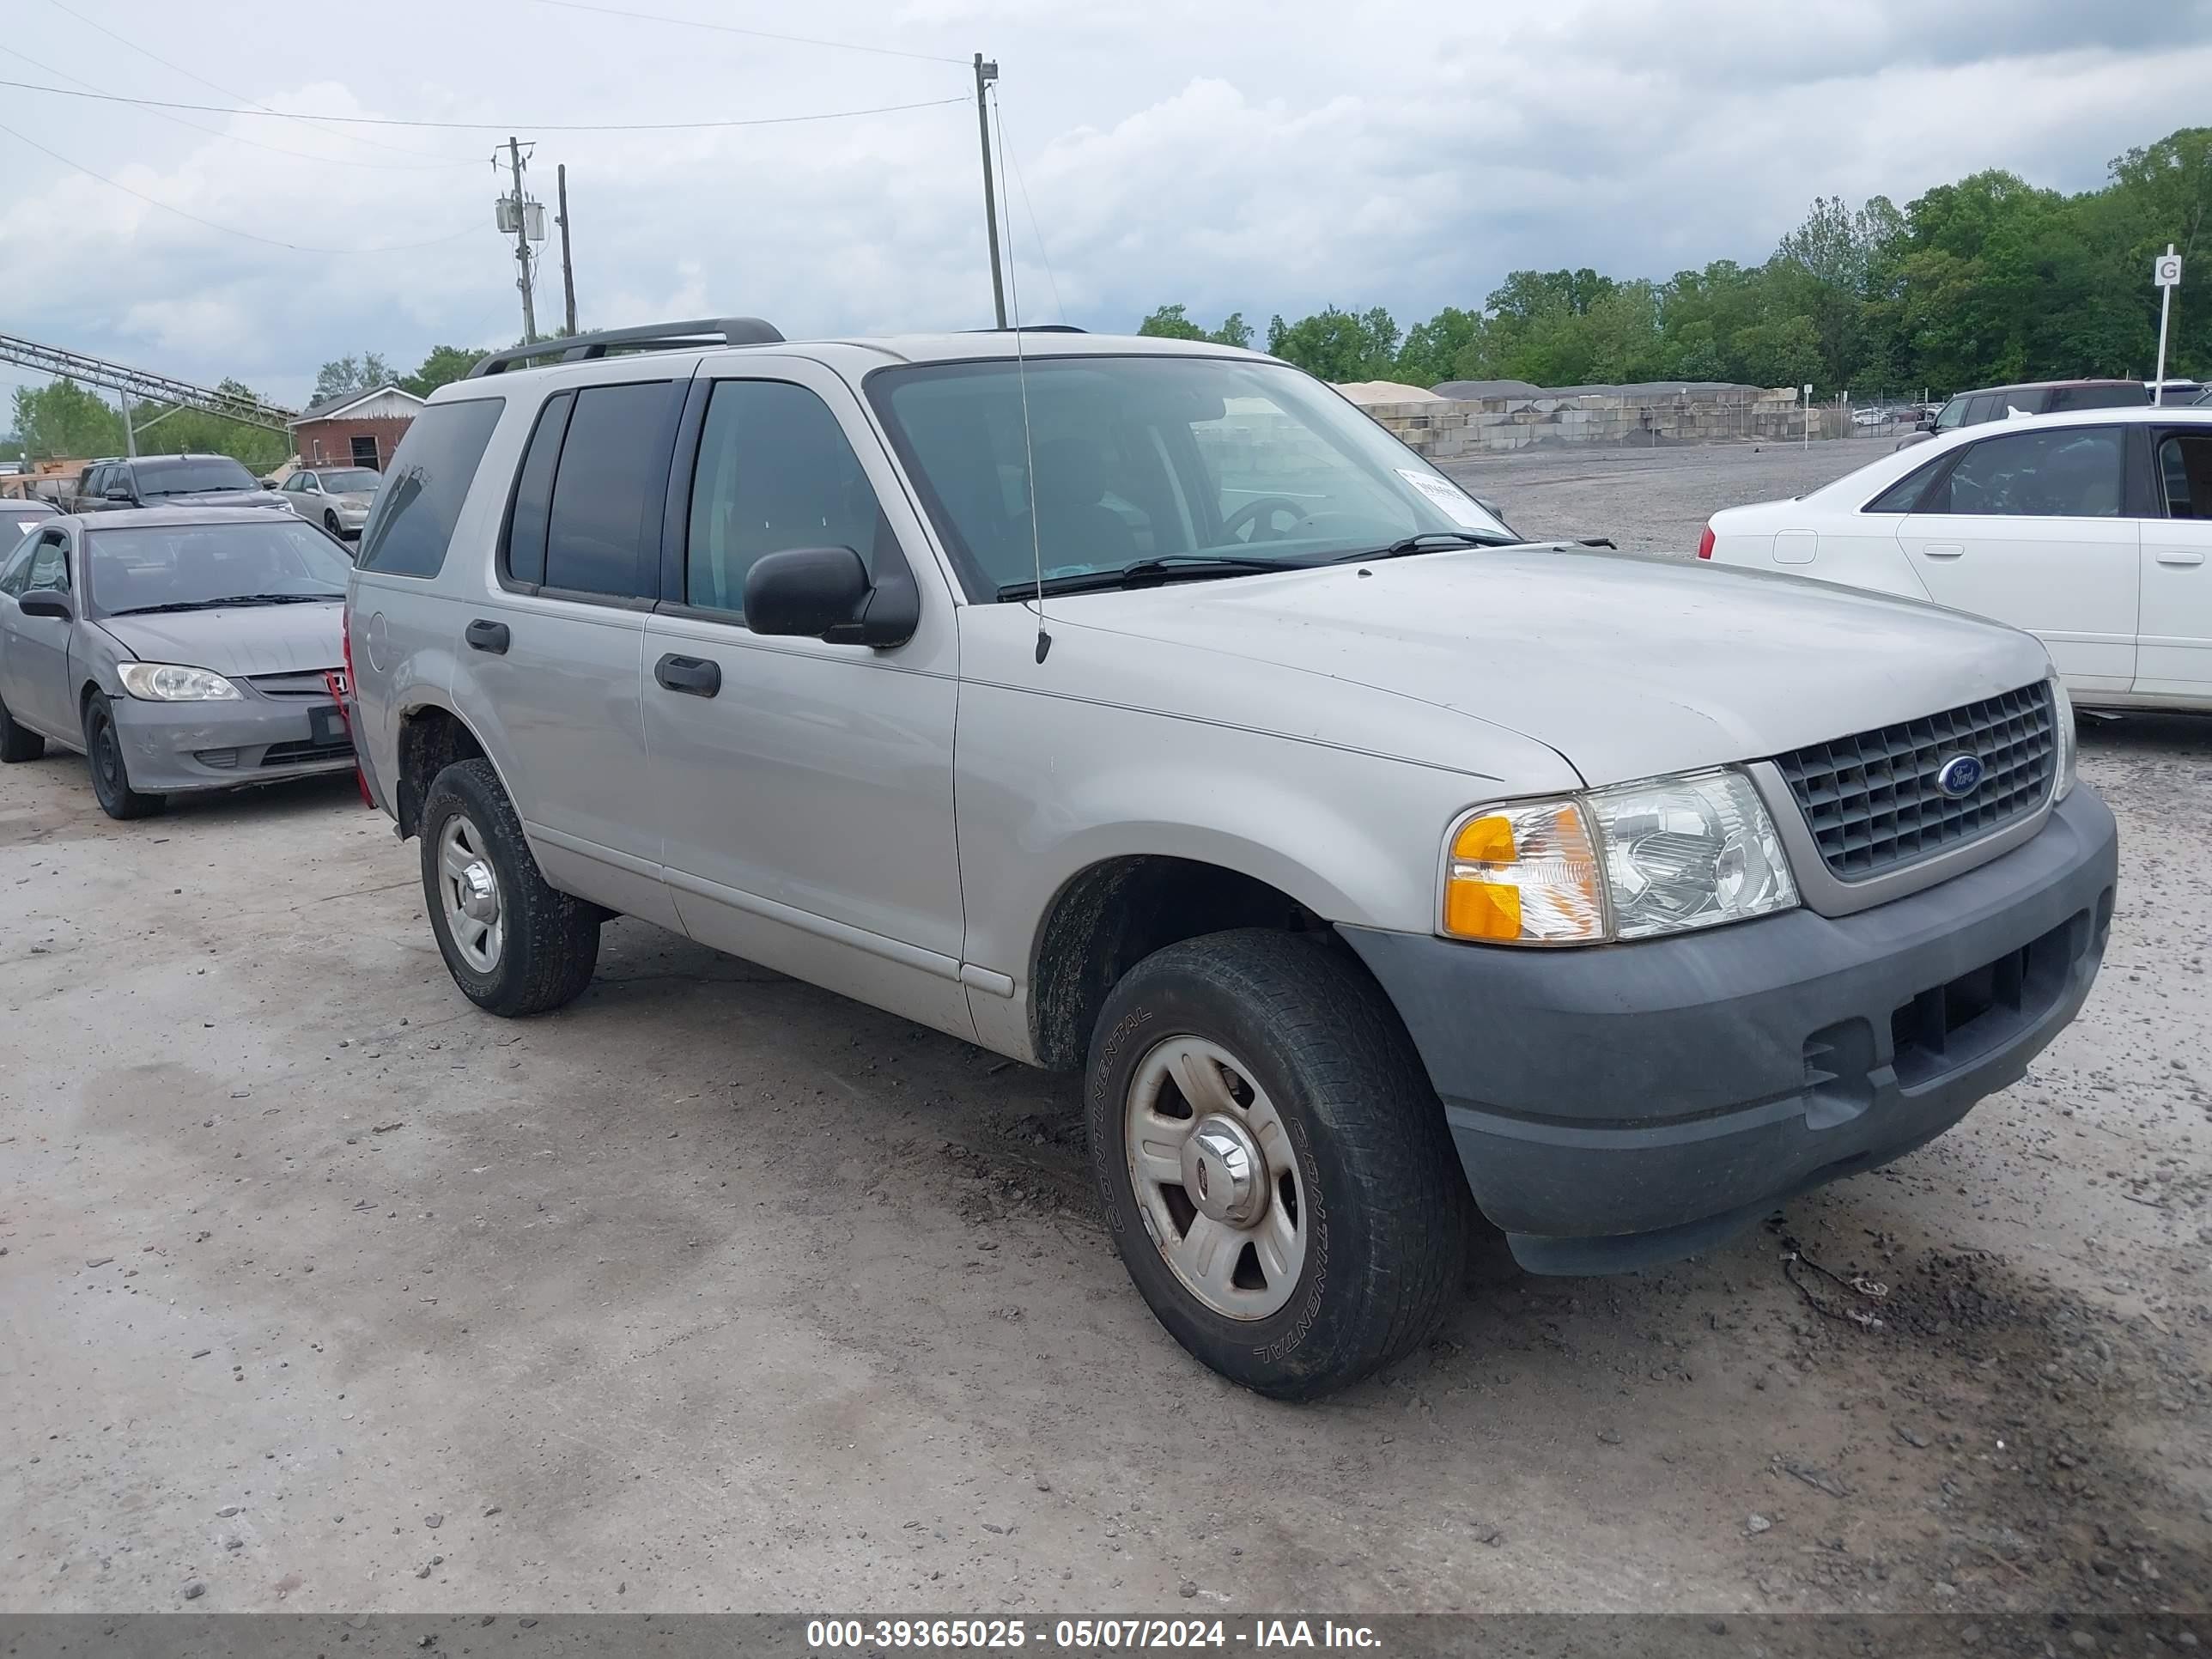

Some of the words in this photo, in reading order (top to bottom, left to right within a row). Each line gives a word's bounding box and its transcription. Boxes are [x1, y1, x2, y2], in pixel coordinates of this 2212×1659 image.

[2160, 261, 2178, 279] G
[1953, 764, 1974, 787] Ford
[1092, 1006, 1153, 1233] CONTINENTAL
[1252, 1117, 1329, 1364] CONTINENTAL
